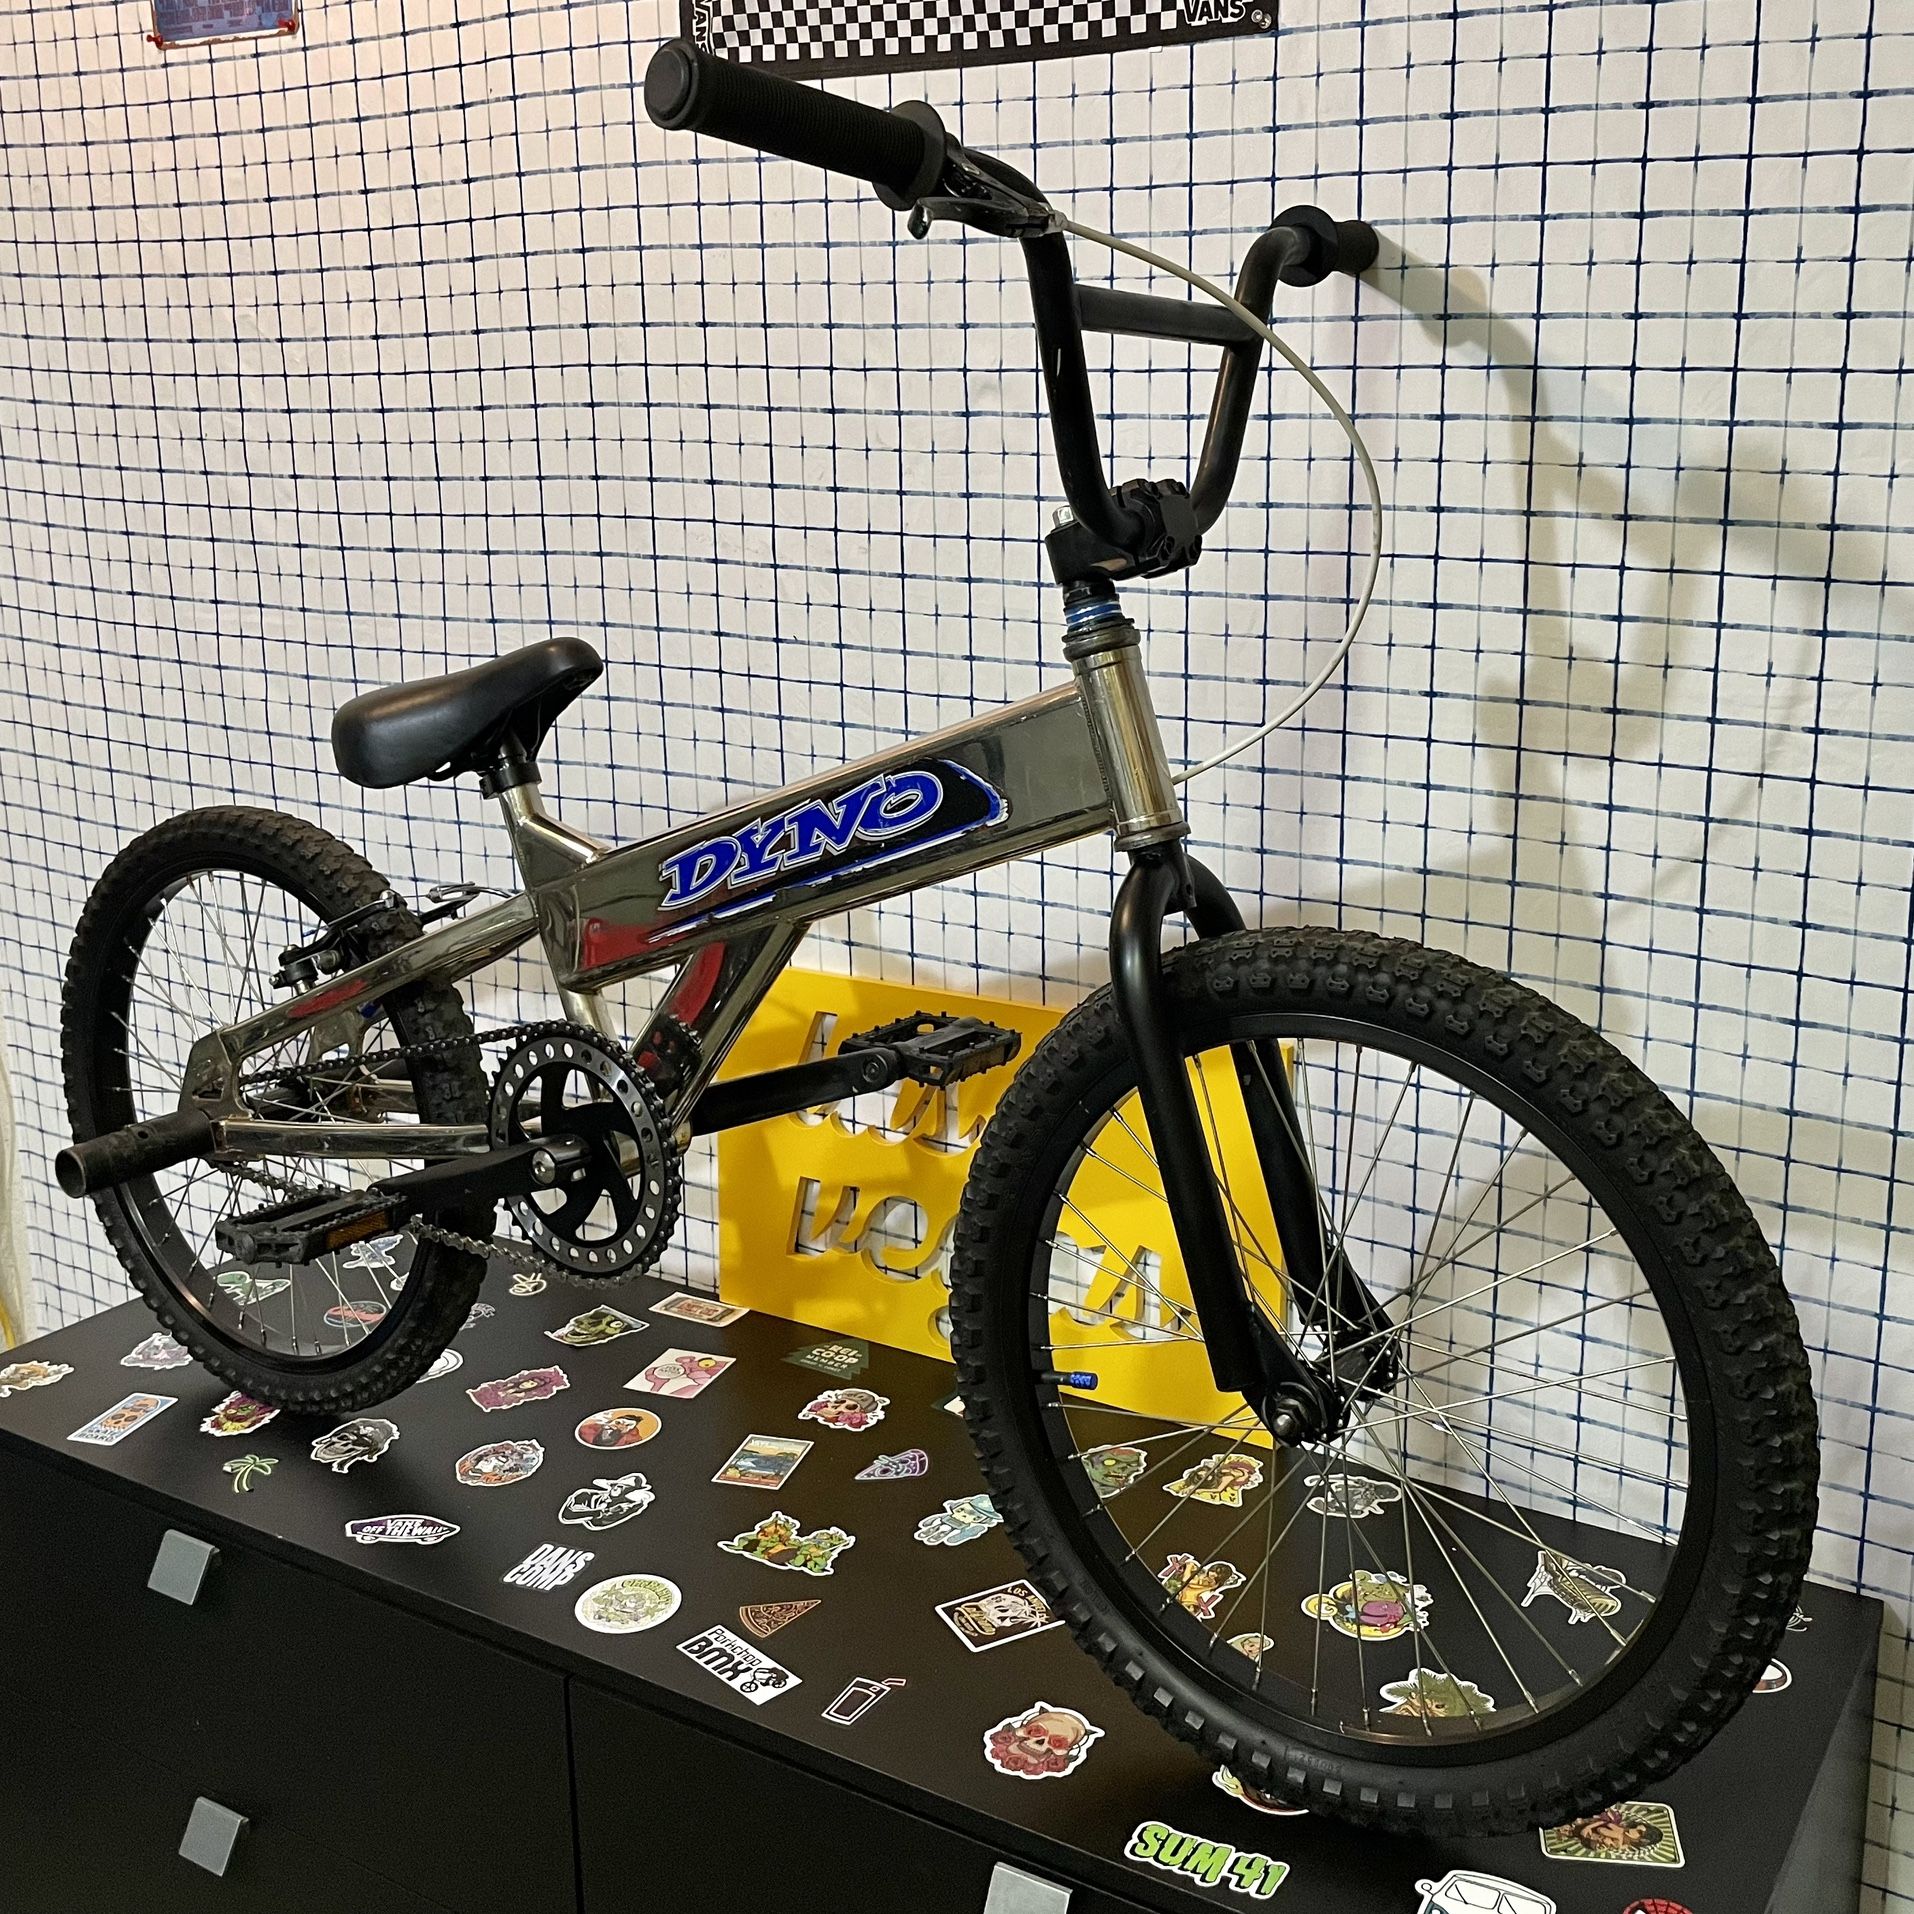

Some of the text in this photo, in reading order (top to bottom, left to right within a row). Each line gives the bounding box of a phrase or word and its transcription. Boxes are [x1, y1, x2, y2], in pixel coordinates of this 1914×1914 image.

[1182, 0, 1247, 25] VANS
[658, 772, 944, 911] DYNO
[362, 1526, 386, 1534] OFF
[522, 1543, 595, 1573] DANS
[503, 1564, 575, 1591] COMP
[1006, 1586, 1028, 1597] LOS
[682, 1636, 753, 1682] BMX
[707, 1628, 762, 1668] Porkchop
[1130, 1824, 1287, 1896] SUM 41
